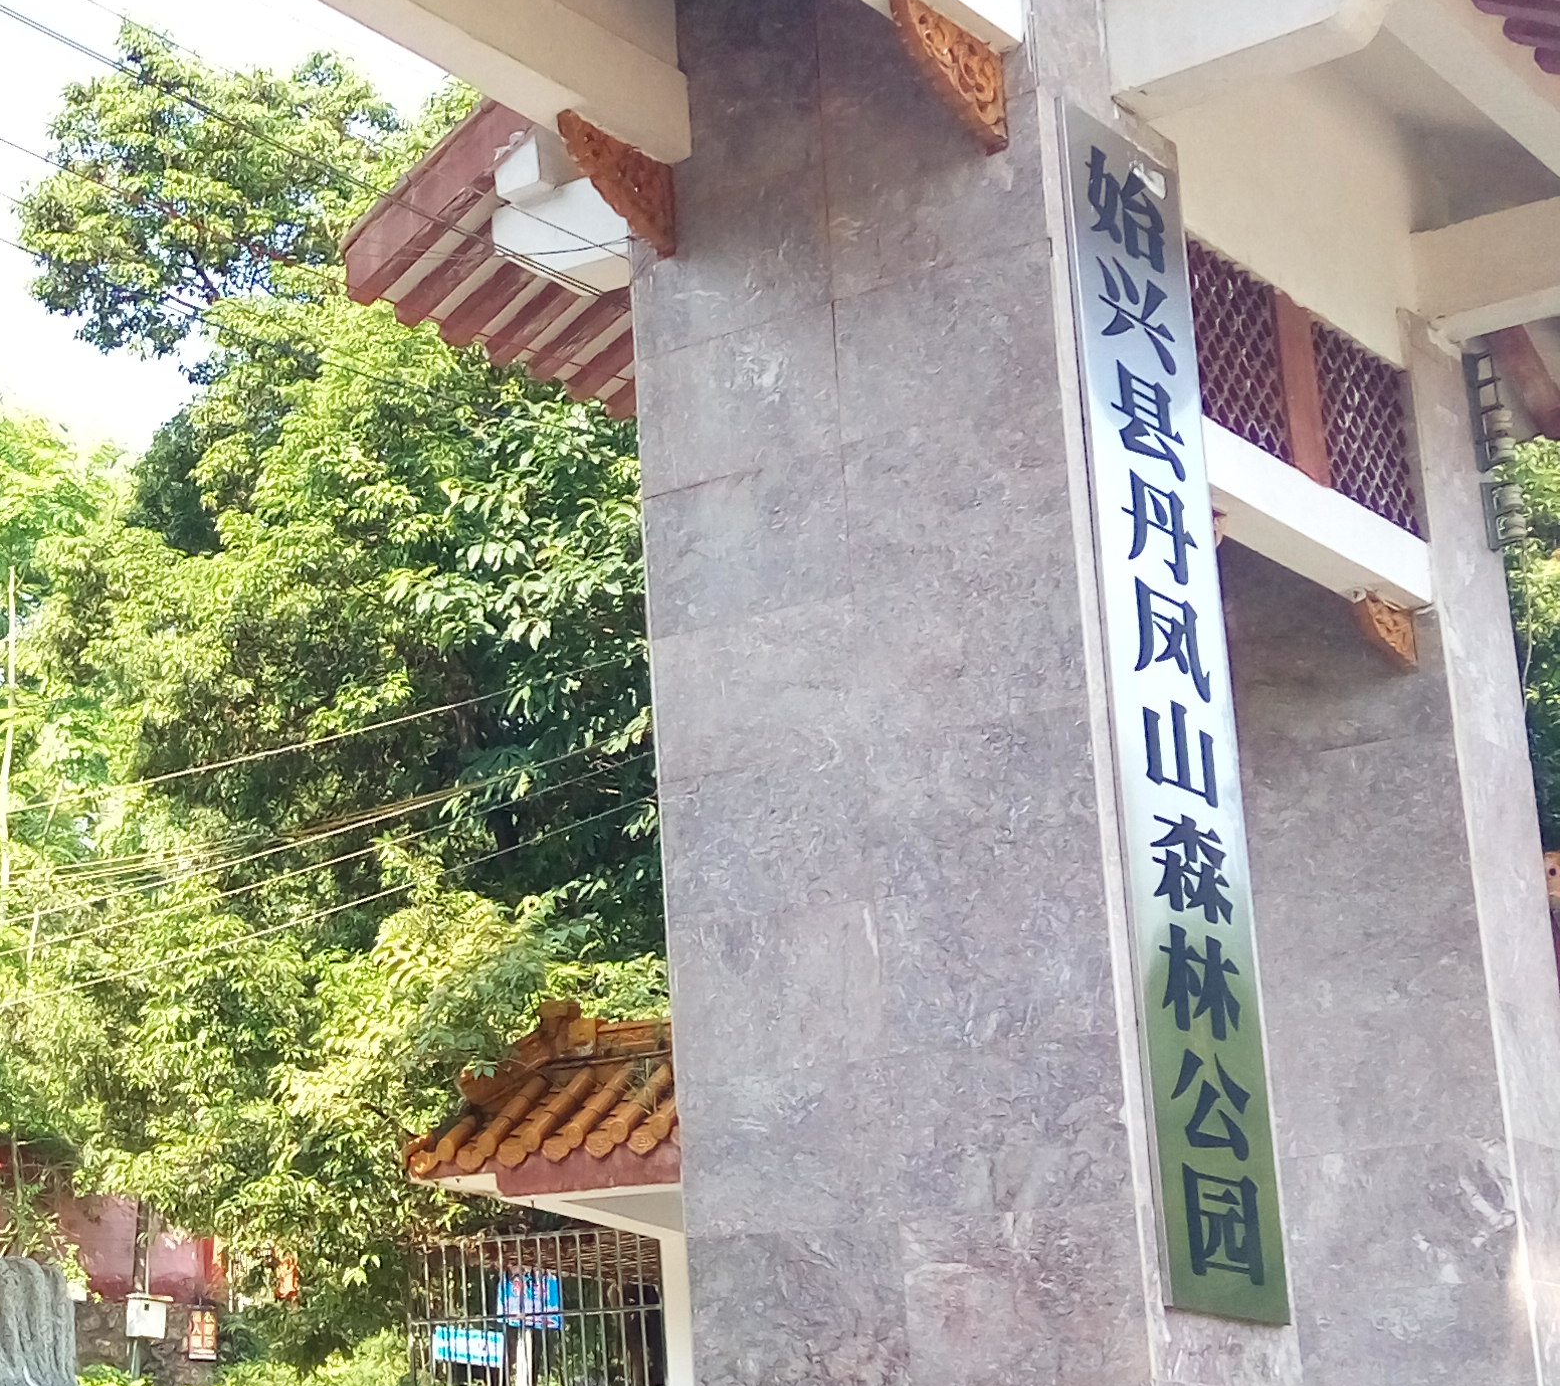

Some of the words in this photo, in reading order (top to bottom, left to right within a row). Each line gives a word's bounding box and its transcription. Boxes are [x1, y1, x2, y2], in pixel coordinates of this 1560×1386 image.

[1086, 145, 1265, 1286] 始兴县丹凤山森林公园
